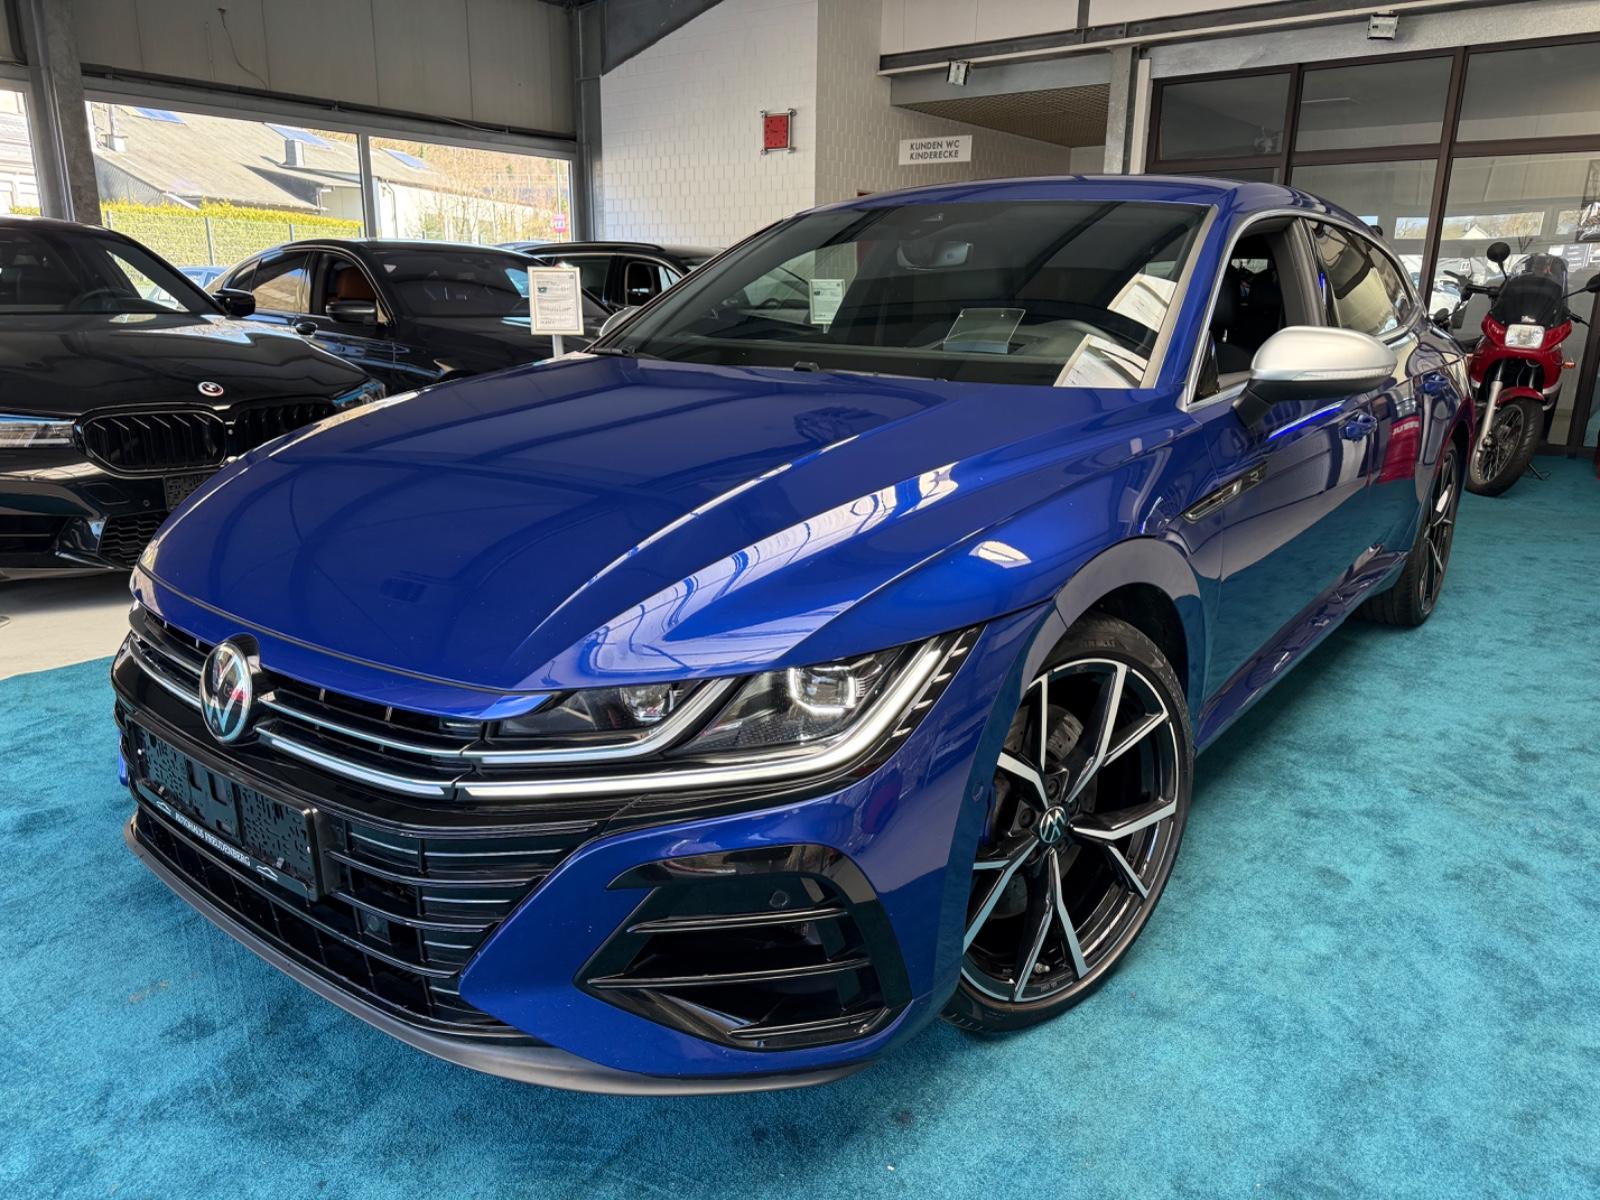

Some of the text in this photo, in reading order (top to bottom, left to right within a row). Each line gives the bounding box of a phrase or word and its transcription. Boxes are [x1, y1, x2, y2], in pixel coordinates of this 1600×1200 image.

[910, 139, 960, 151] KUNDEN WC
[909, 149, 959, 160] KINDERECKE
